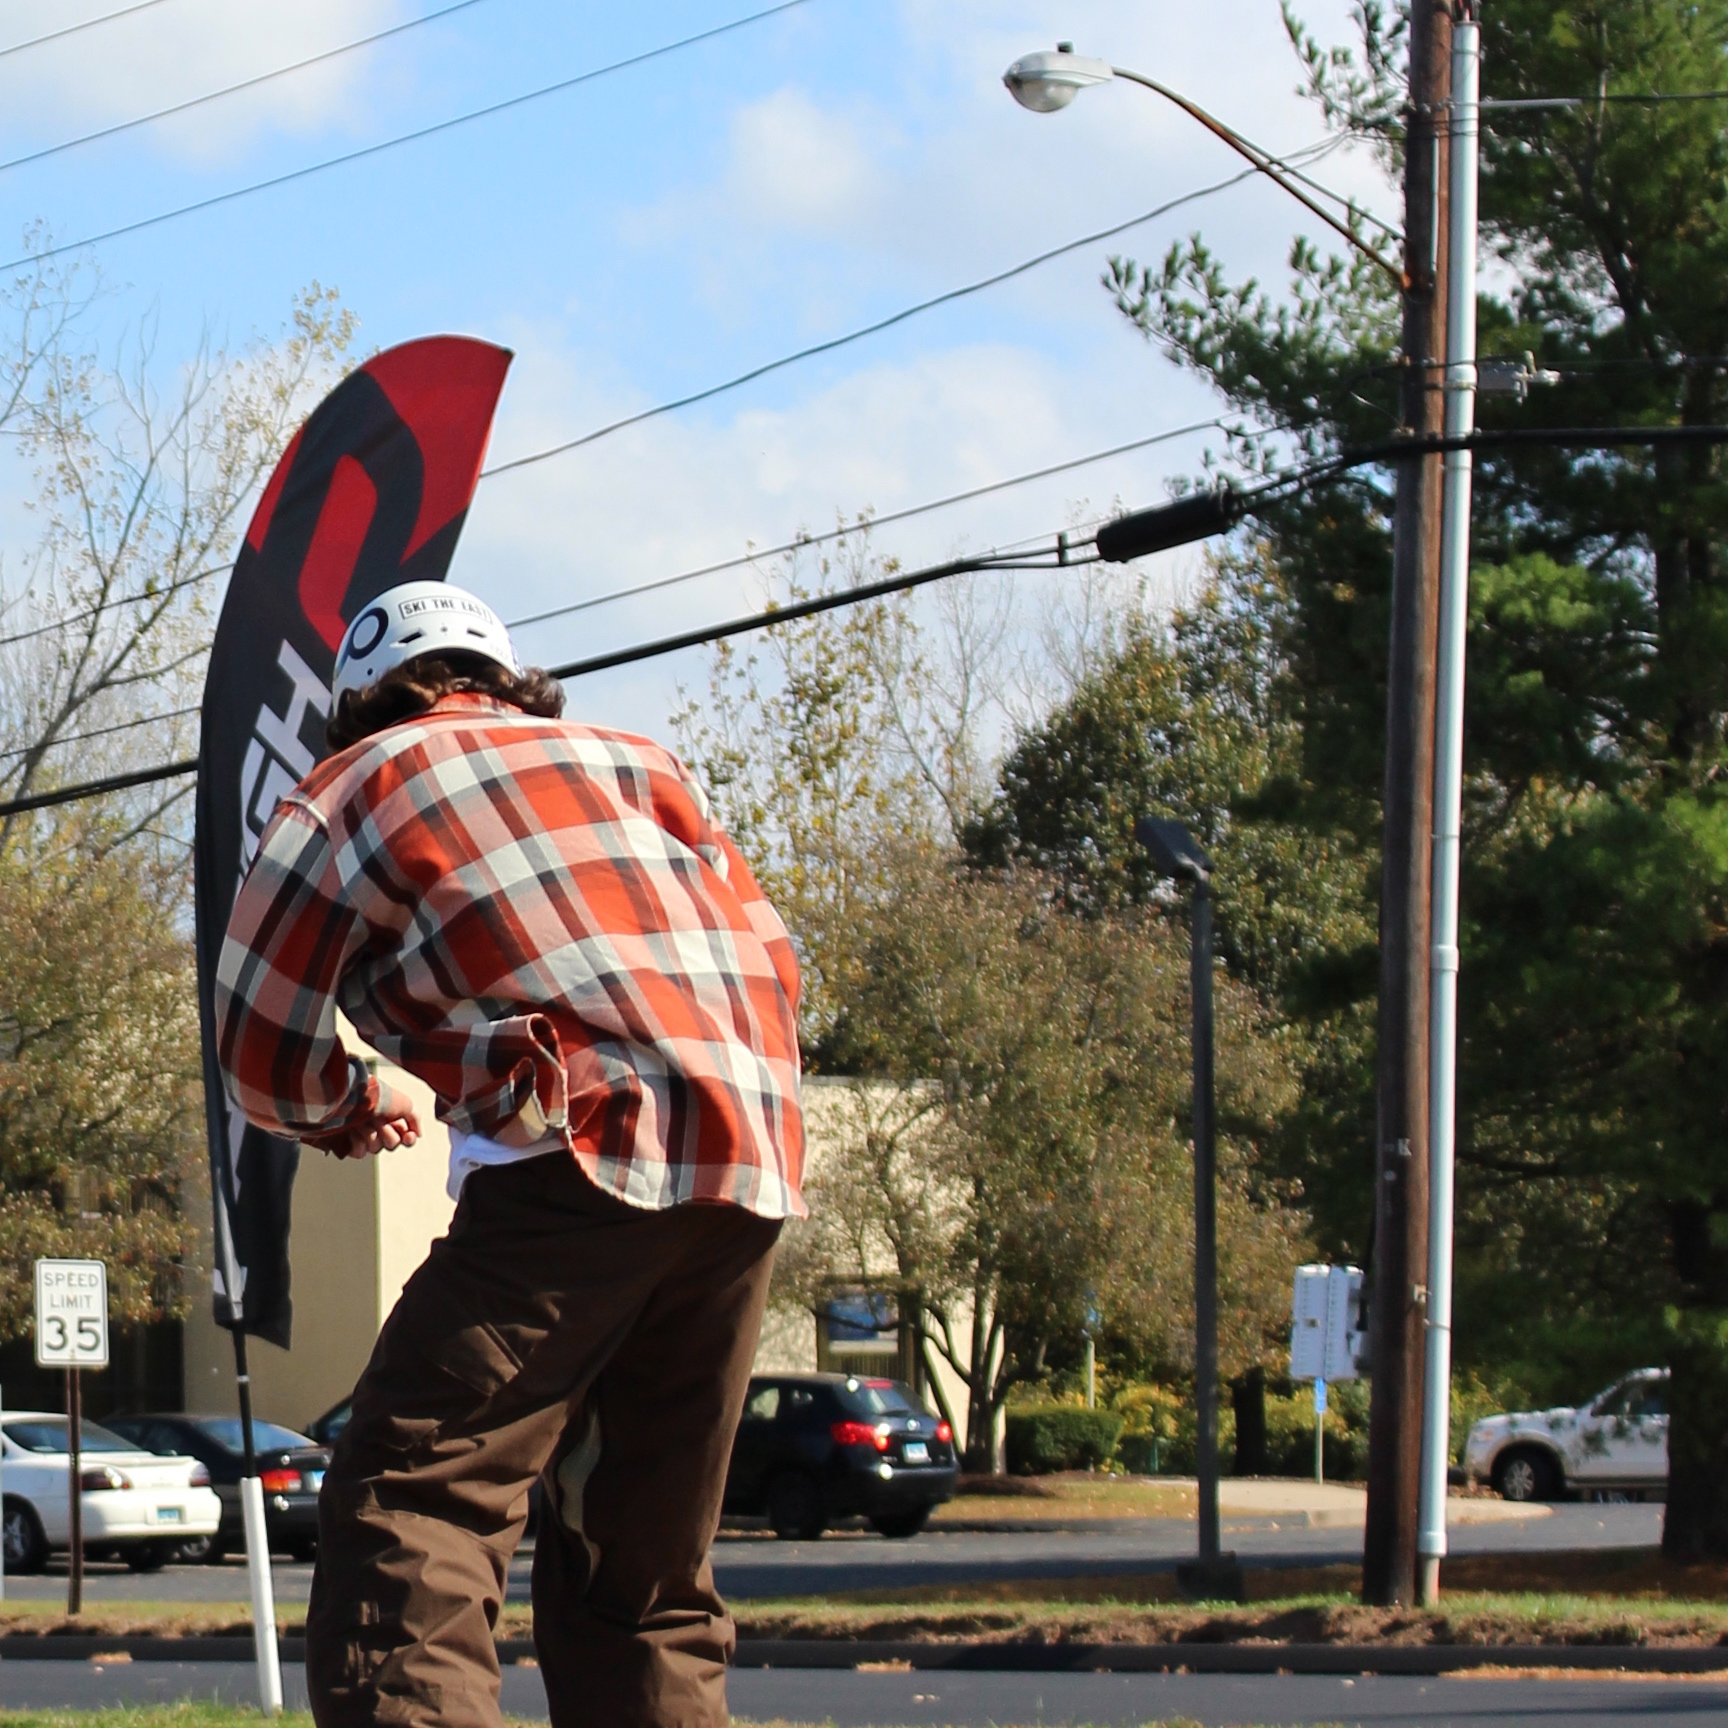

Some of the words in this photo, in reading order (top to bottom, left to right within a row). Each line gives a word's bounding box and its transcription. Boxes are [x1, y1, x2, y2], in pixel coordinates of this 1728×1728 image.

[403, 600, 427, 615] SKI
[432, 599, 456, 610] THE
[44, 1272, 99, 1287] SPEED
[50, 1294, 92, 1308] LIMIT
[45, 1315, 101, 1351] 35
